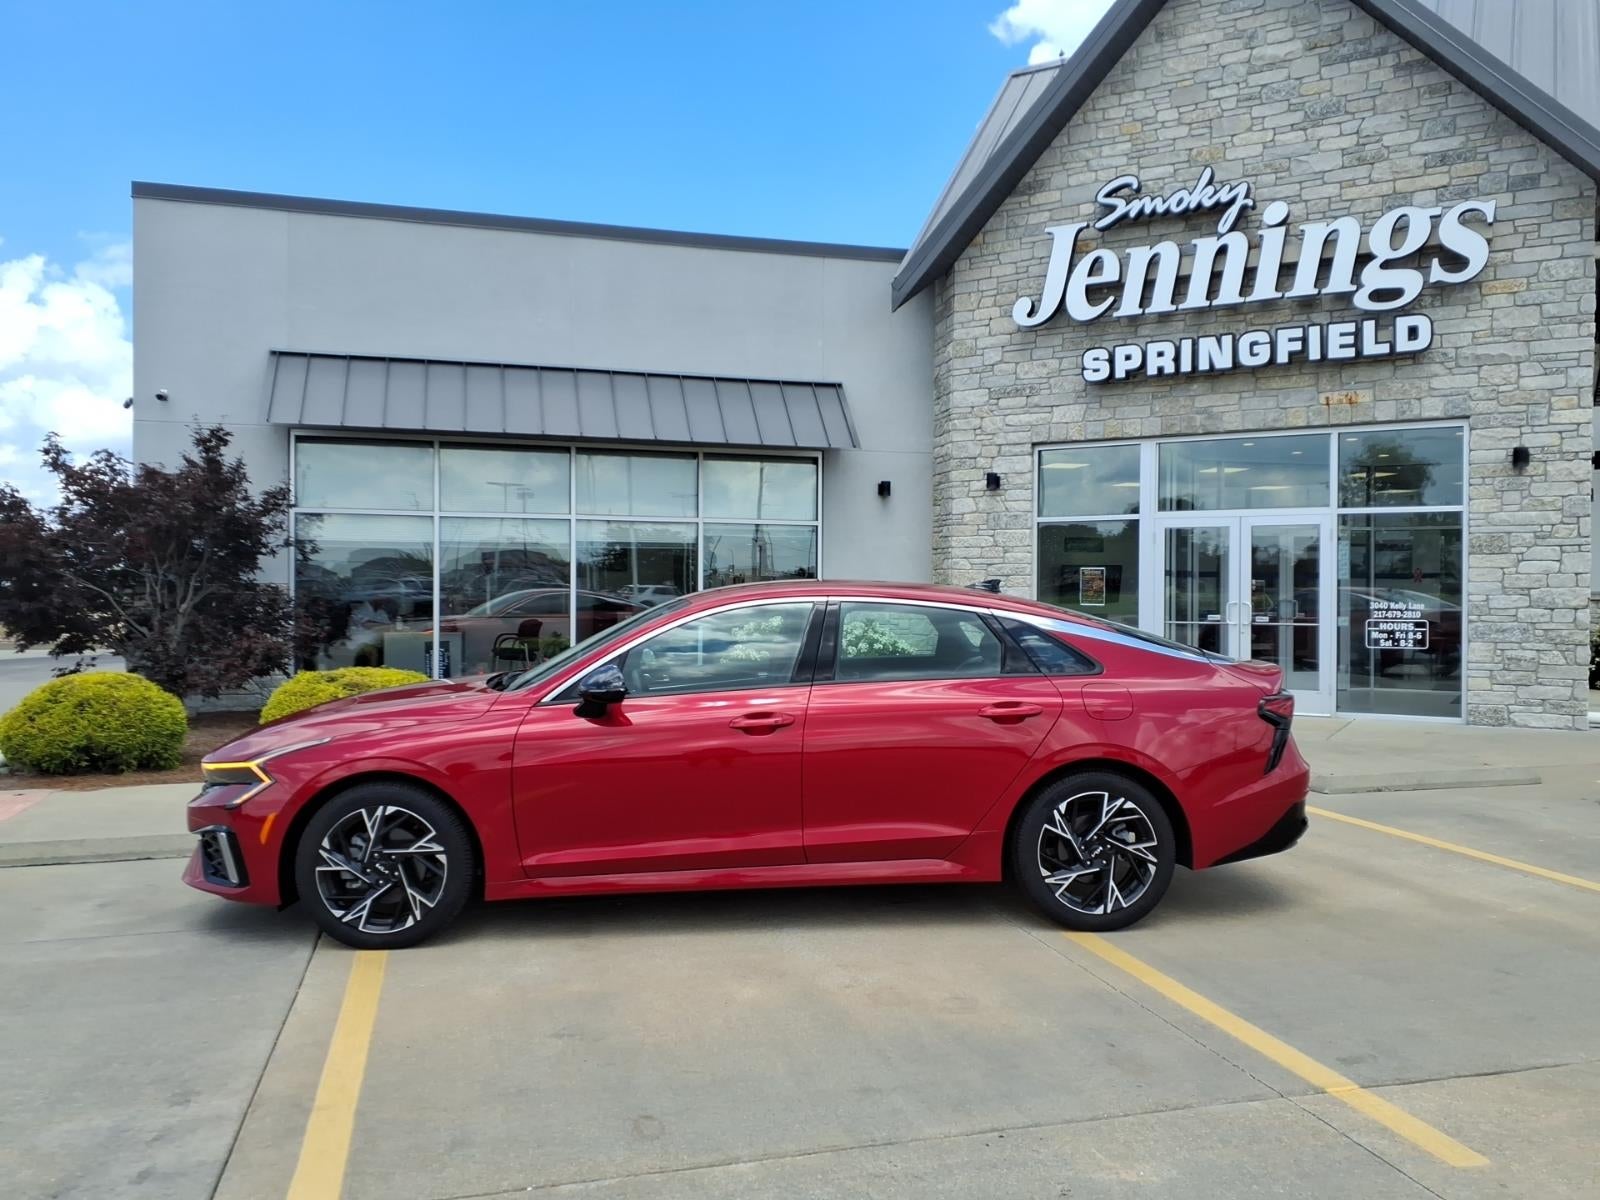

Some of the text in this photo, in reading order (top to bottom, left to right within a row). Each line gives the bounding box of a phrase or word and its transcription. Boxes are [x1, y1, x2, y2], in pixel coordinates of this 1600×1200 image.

[1095, 166, 1256, 234] Smoky
[1012, 199, 1496, 327] Jennings
[1082, 313, 1433, 383] SPRINGFIELD
[1371, 631, 1388, 639] Mon
[1395, 631, 1406, 639] Fri
[1389, 602, 1406, 610] Kelly
